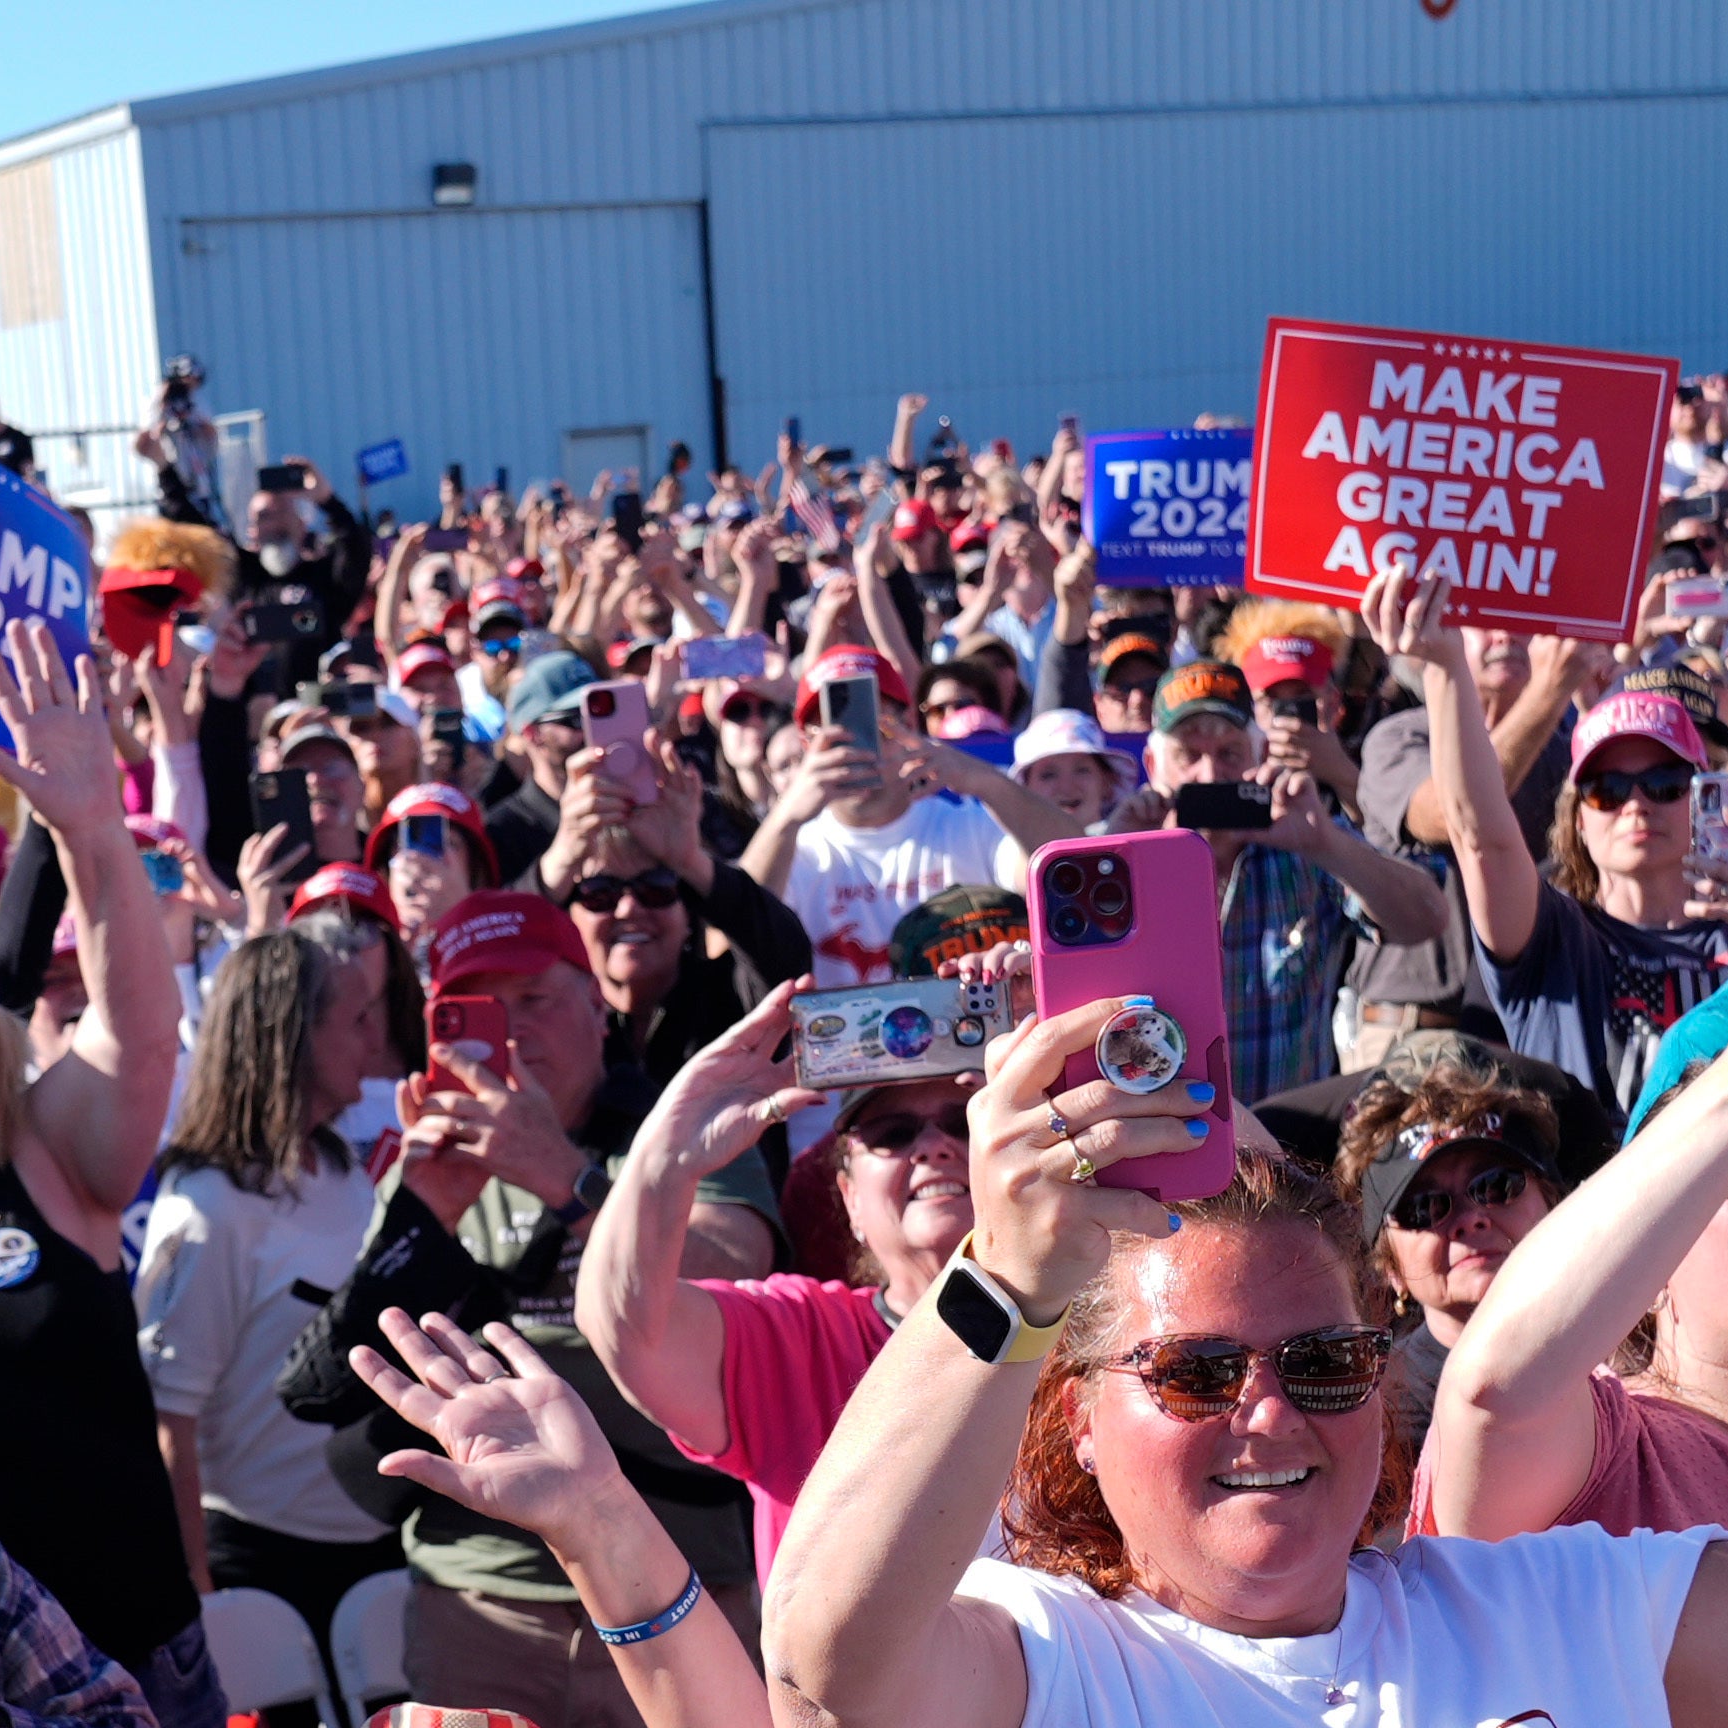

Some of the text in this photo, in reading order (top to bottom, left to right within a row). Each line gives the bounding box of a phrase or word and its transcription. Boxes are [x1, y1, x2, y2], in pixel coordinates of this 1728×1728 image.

[1368, 359, 1563, 427] MAKE
[1302, 411, 1605, 490] AMERICA
[1336, 471, 1563, 540] GREAT
[1147, 541, 1204, 558] TRUMP
[1323, 525, 1557, 597] AGAIN!
[624, 1630, 641, 1641] IN
[670, 1585, 700, 1623] TRUST
